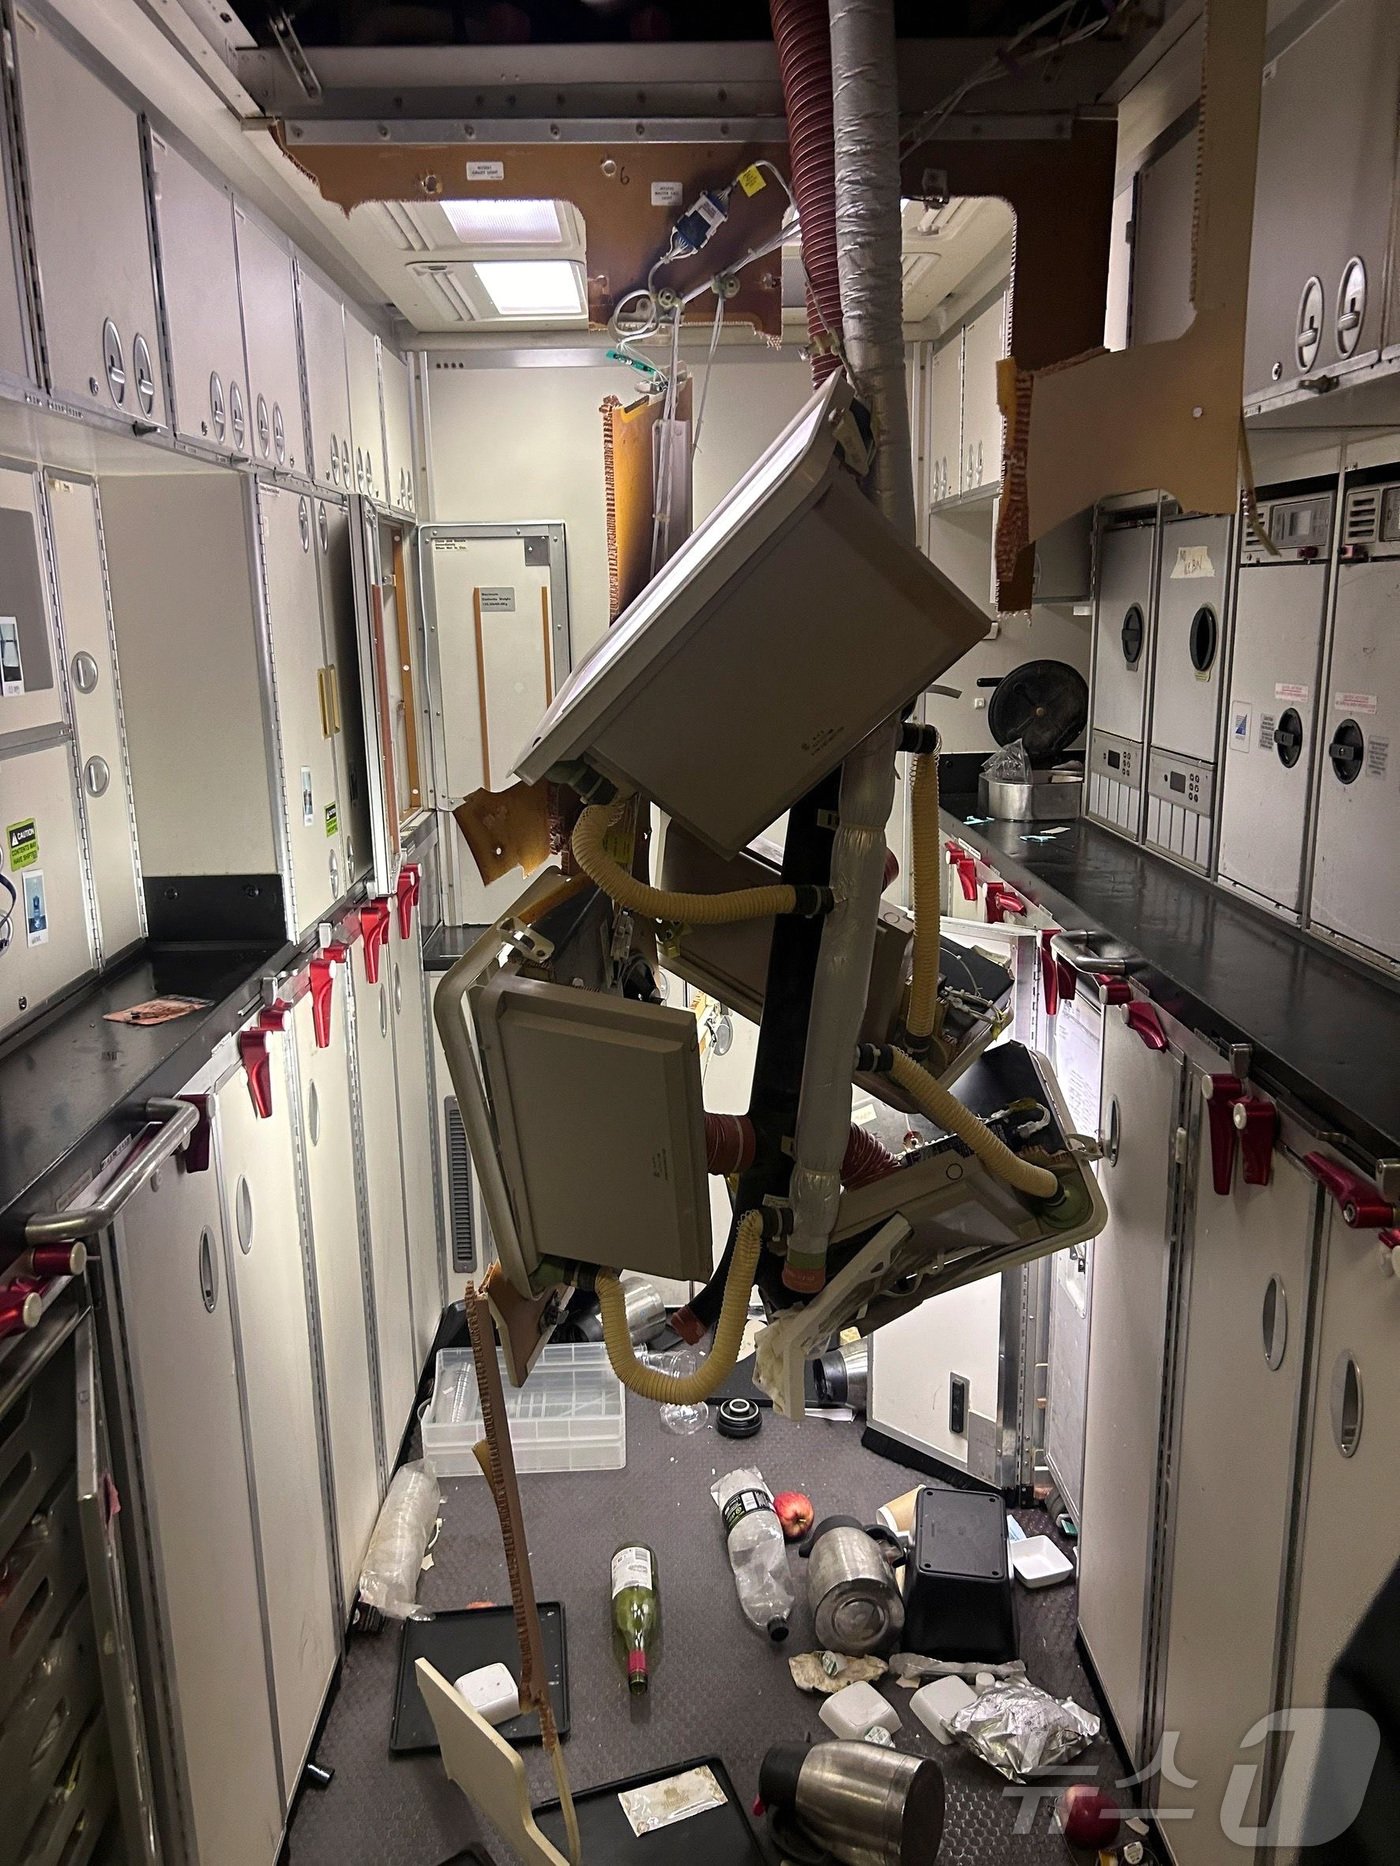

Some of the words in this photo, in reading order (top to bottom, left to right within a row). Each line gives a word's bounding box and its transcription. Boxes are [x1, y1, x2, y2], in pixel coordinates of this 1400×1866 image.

[17, 828, 35, 841] CAUTION
[12, 845, 29, 857] CONTENTS
[13, 855, 23, 865] HAVE
